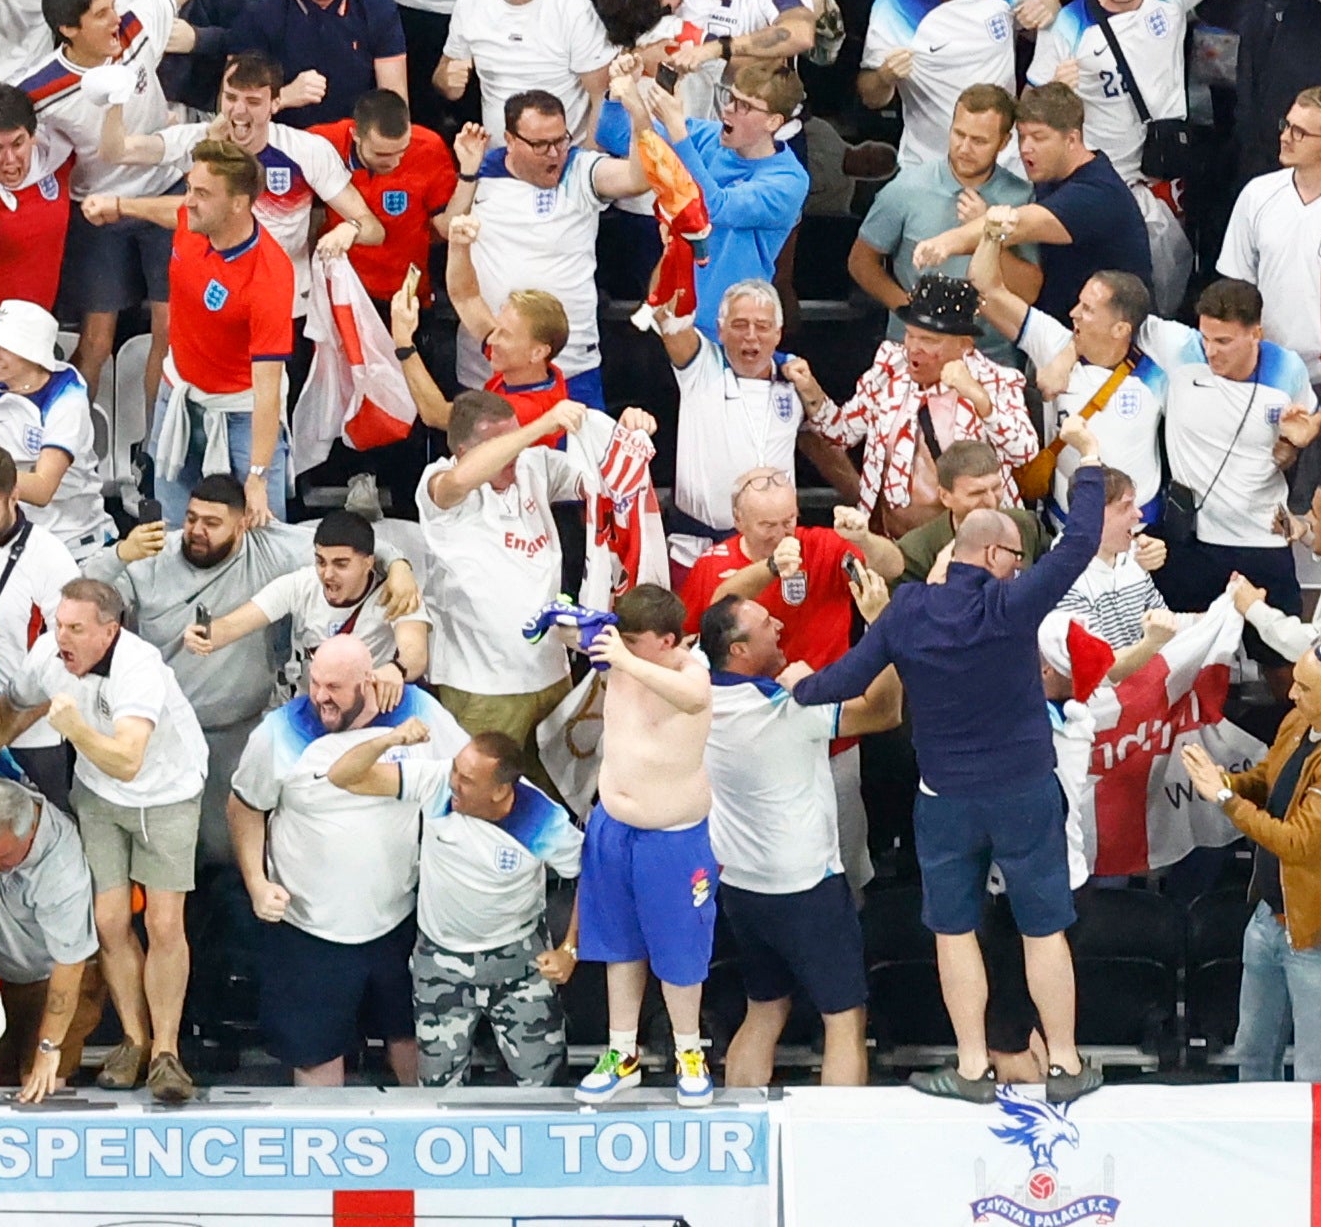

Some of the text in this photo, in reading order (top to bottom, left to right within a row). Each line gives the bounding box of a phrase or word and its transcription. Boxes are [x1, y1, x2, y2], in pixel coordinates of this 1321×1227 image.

[413, 1124, 523, 1176] ON
[547, 1121, 756, 1175] TOUR
[1034, 1203, 1087, 1227] PALACE
